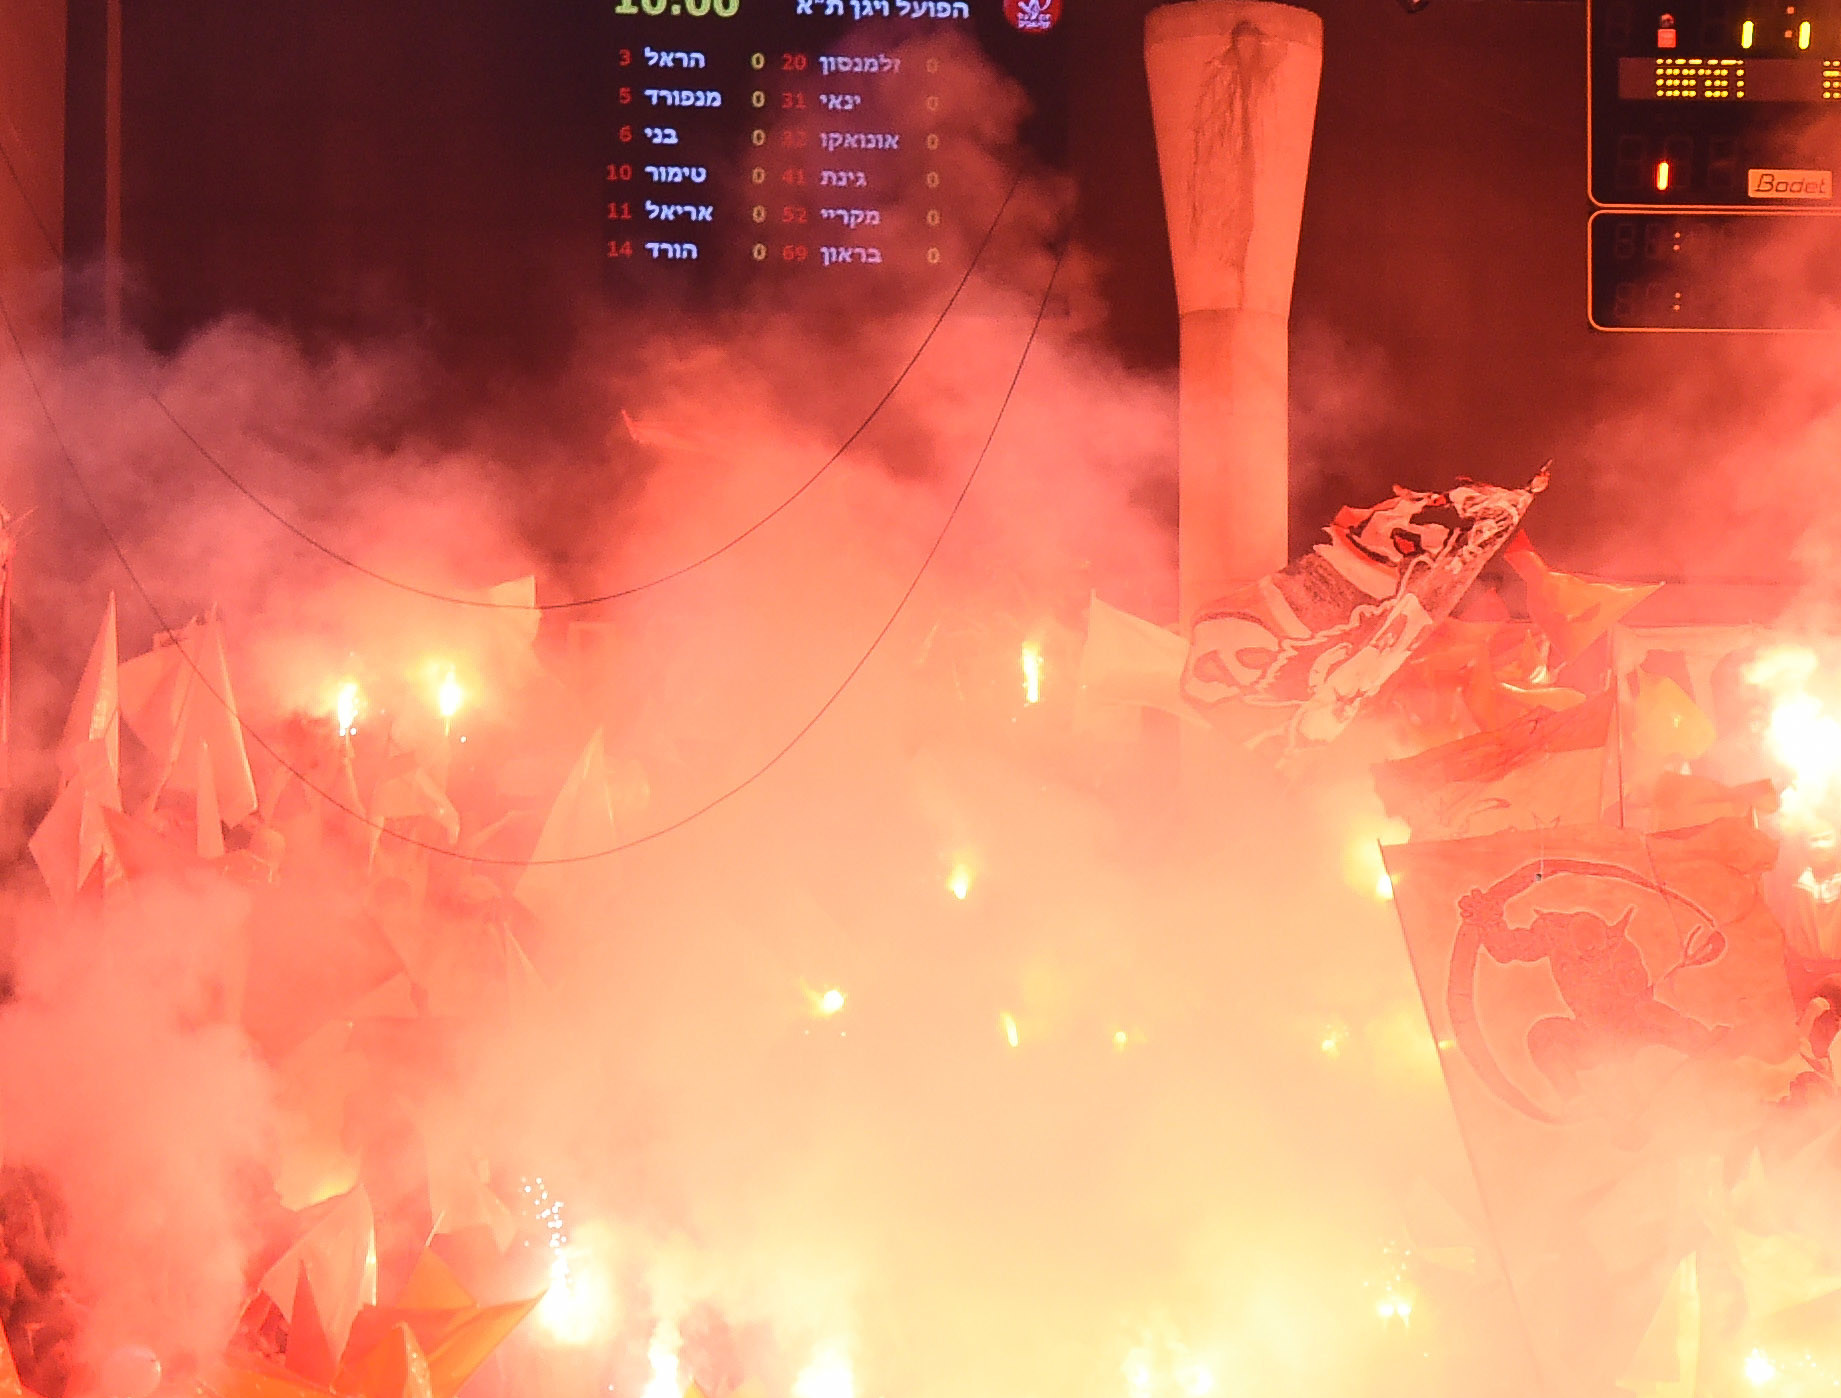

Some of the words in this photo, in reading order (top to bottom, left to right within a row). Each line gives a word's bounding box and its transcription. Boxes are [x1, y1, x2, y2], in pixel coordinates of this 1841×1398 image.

[620, 48, 633, 67] 3
[644, 46, 706, 69] הראל
[751, 52, 765, 70] 0
[619, 86, 633, 105] 5
[643, 89, 722, 107] מנפורד
[751, 90, 765, 108] 0
[819, 94, 861, 110] ינאי
[619, 124, 633, 143] 6
[643, 127, 679, 145] בני
[752, 129, 766, 146] 0
[607, 163, 633, 181] 10
[644, 165, 707, 184] טימור
[752, 167, 766, 184] 0
[820, 170, 867, 187] גינת
[1753, 172, 1828, 194] Bodet
[607, 202, 632, 220] 11
[644, 199, 714, 222] אריאל
[752, 205, 766, 223] 0
[609, 241, 633, 257] 14
[644, 242, 698, 260] הורד
[752, 243, 767, 260] 0
[820, 246, 882, 266] בראון
